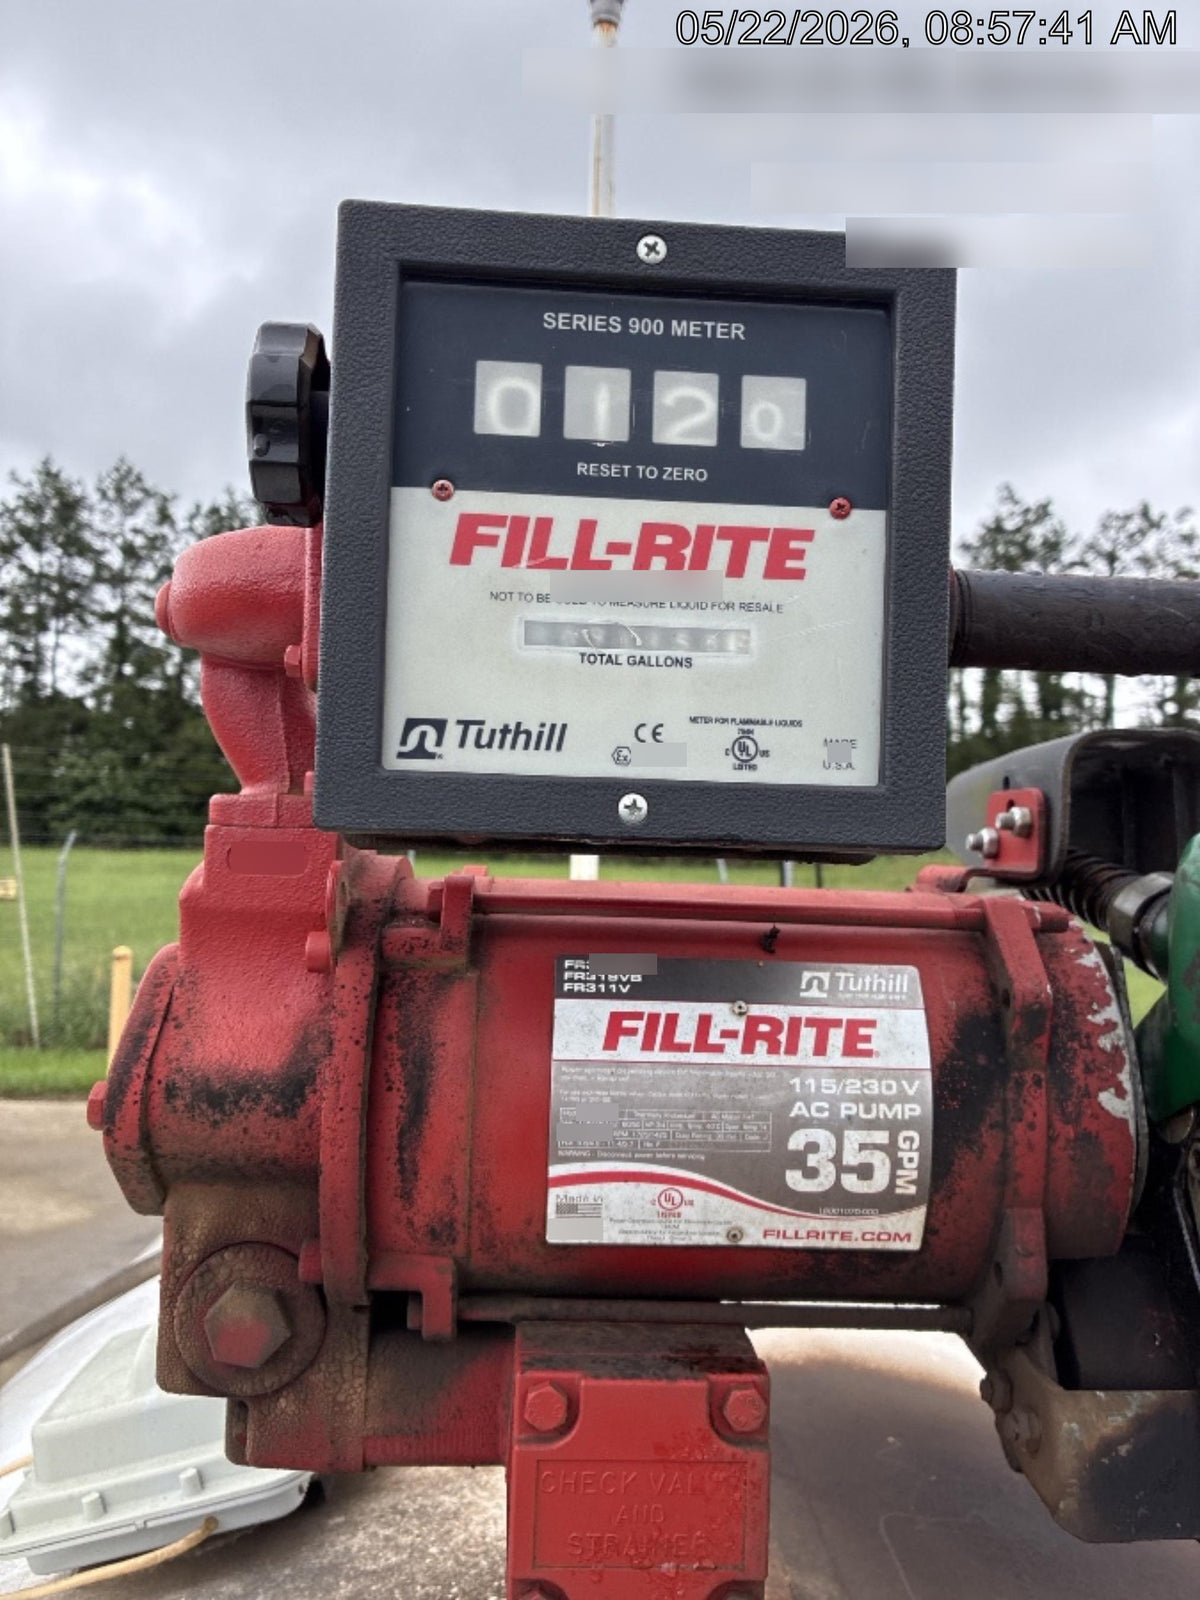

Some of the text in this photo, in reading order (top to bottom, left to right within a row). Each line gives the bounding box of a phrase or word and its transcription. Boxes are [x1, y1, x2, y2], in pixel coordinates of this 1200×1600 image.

[542, 312, 746, 341] SERIES 900 METER
[577, 462, 708, 482] RESET TO ZERO
[449, 512, 815, 580] FILL-RITE
[490, 591, 514, 602] NOT
[518, 592, 534, 603] TO
[739, 602, 784, 613] RESALE
[579, 652, 693, 668] TOTAL GALLONS
[455, 719, 568, 752] Tuthill
[634, 723, 664, 743] CE
[563, 983, 631, 993] FR311V
[835, 971, 909, 993] Tuthill
[602, 1011, 878, 1059] FILL-RITE
[789, 1077, 921, 1097] 115/230 V
[789, 1101, 922, 1119] AC PUMP
[785, 1128, 892, 1193] 35
[895, 1130, 920, 1195] GPM
[763, 1229, 912, 1243] FILLRITE.COM
[540, 1471, 637, 1495] CHECK
[616, 1504, 665, 1524] AND
